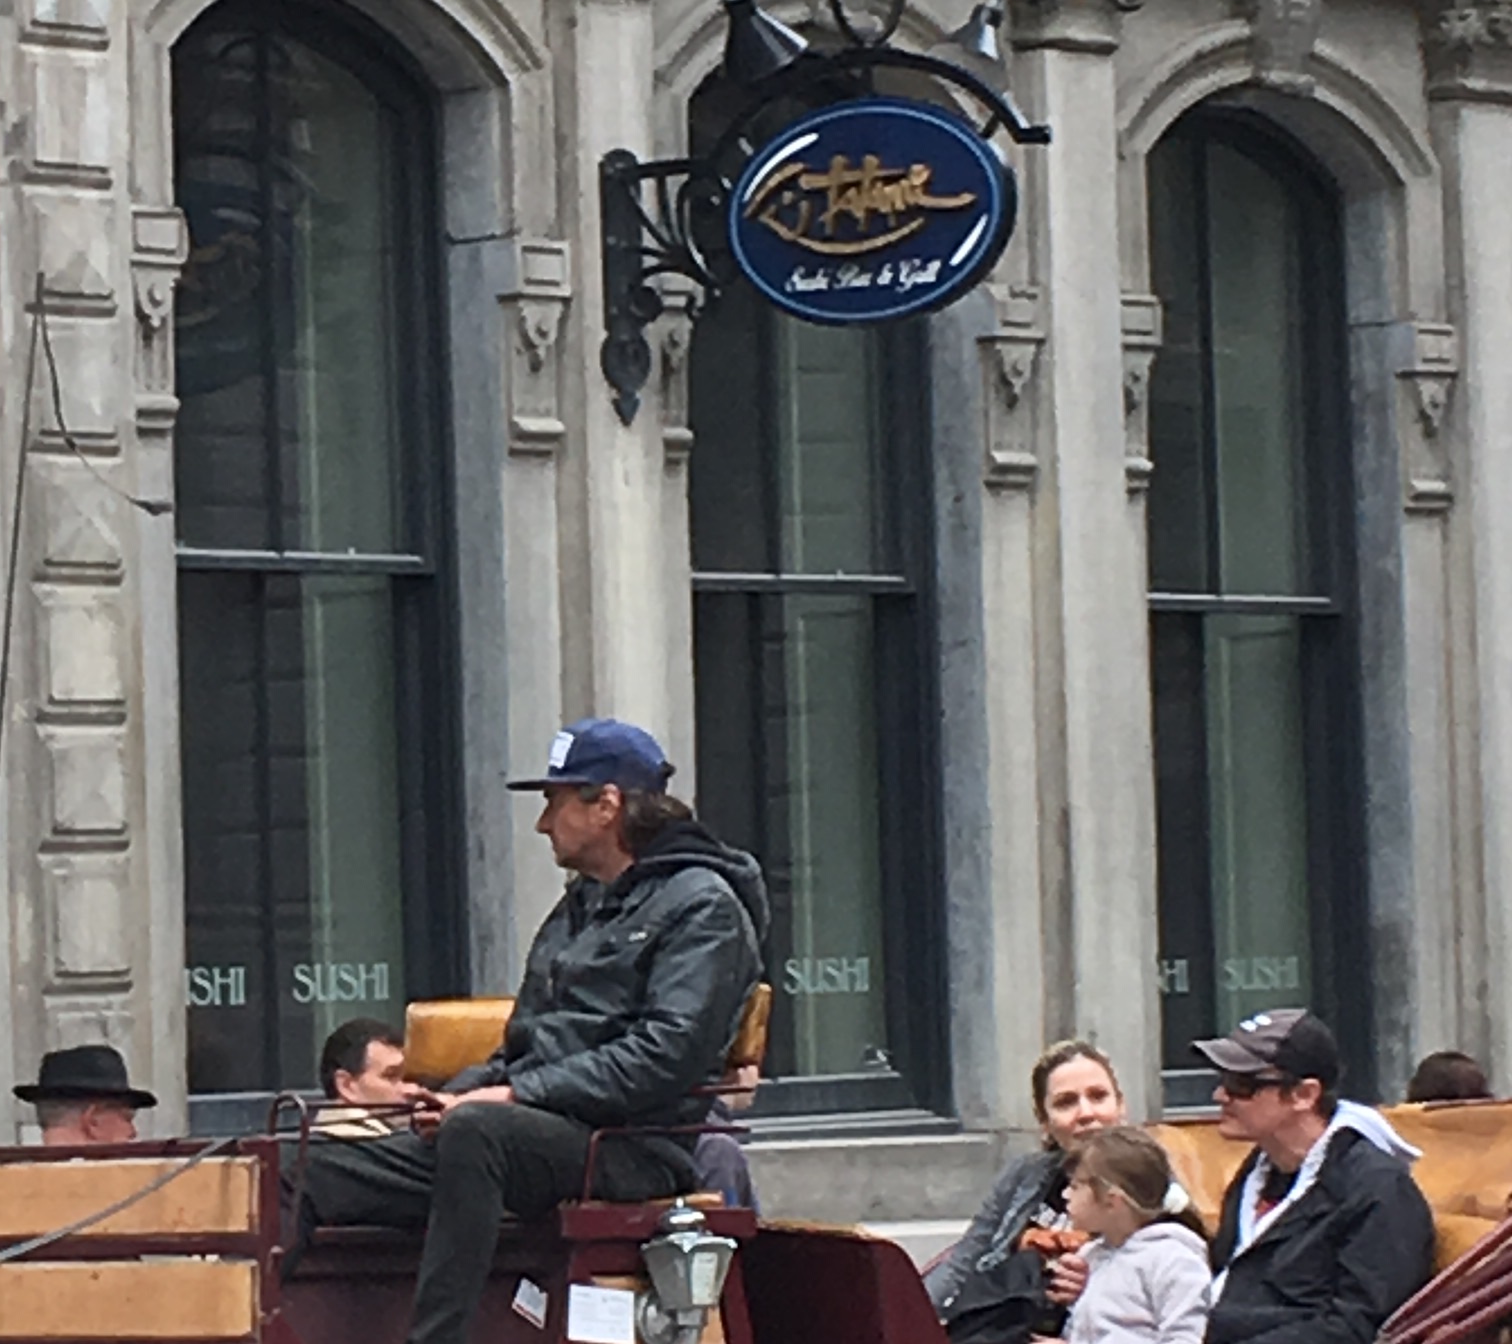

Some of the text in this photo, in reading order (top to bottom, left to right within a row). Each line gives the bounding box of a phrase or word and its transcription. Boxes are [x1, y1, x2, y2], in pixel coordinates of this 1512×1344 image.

[292, 962, 390, 1003] SUSHI
[783, 956, 871, 994] SUSHI
[1223, 956, 1300, 992] SUSHI
